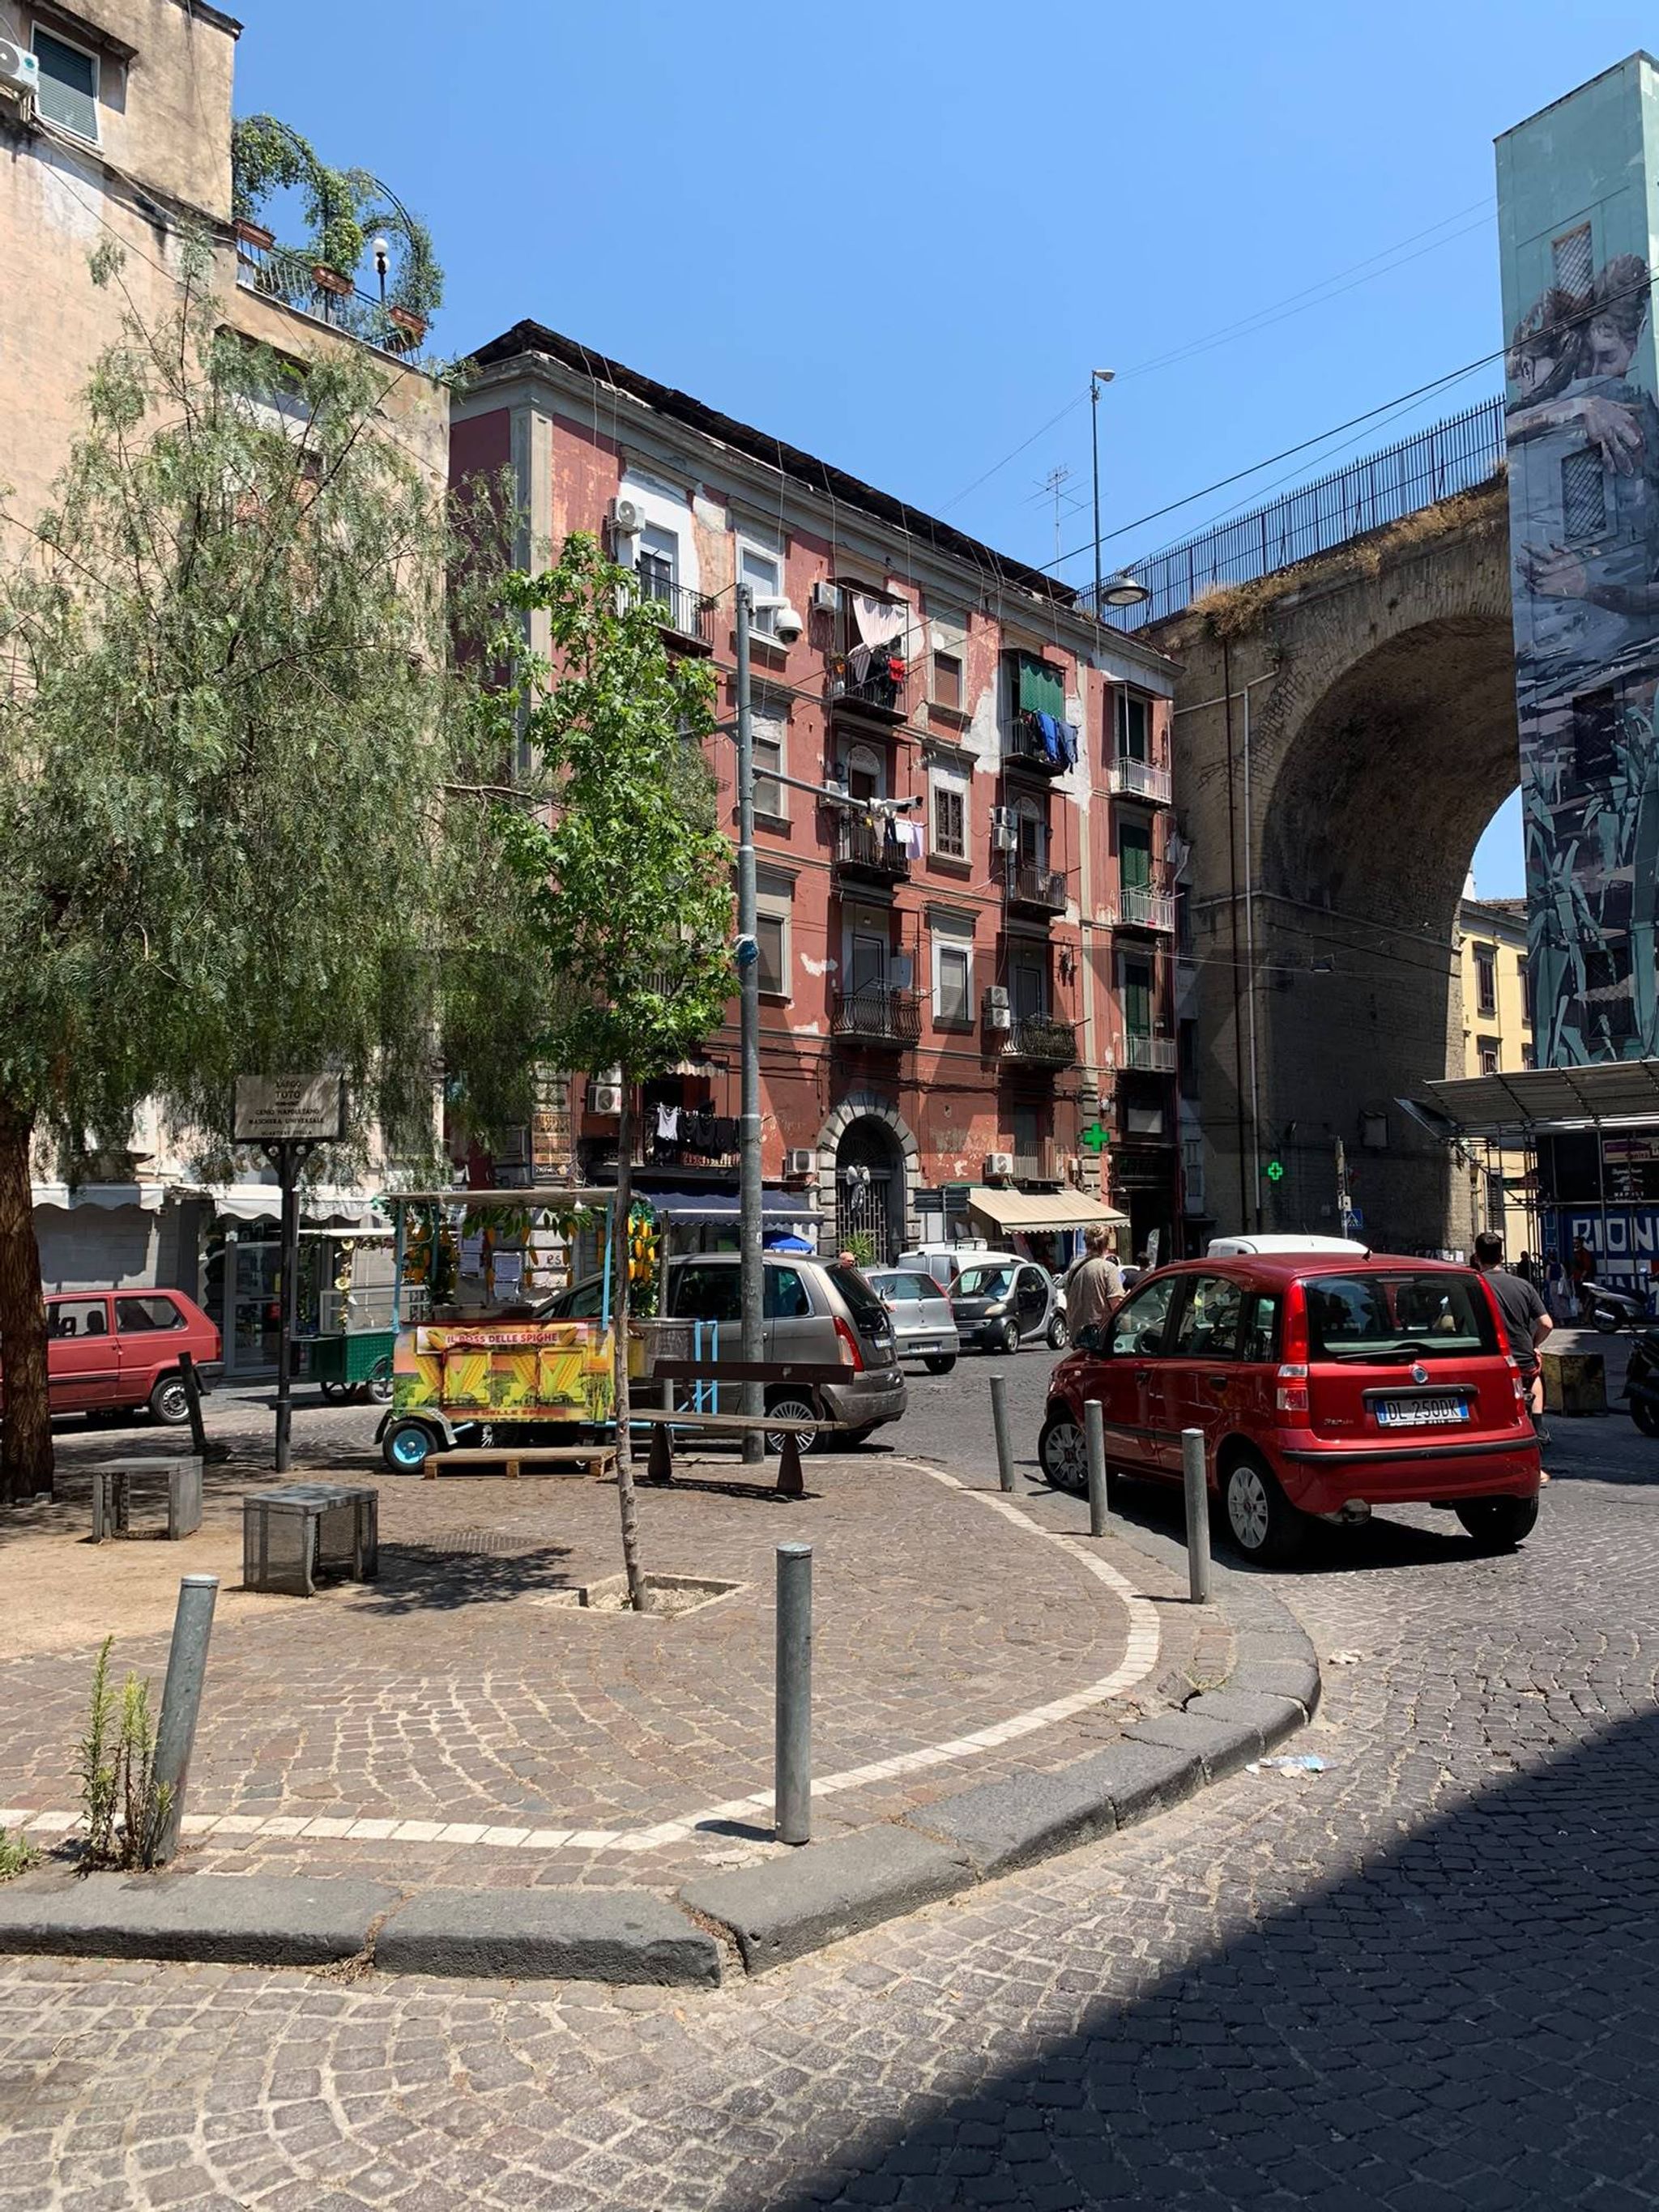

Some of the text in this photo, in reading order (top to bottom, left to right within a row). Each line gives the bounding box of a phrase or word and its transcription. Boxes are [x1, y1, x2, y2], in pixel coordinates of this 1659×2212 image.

[1572, 1217, 1659, 1251] RION
[446, 1332, 557, 1344] IL BOSS DELLE SPIGHE
